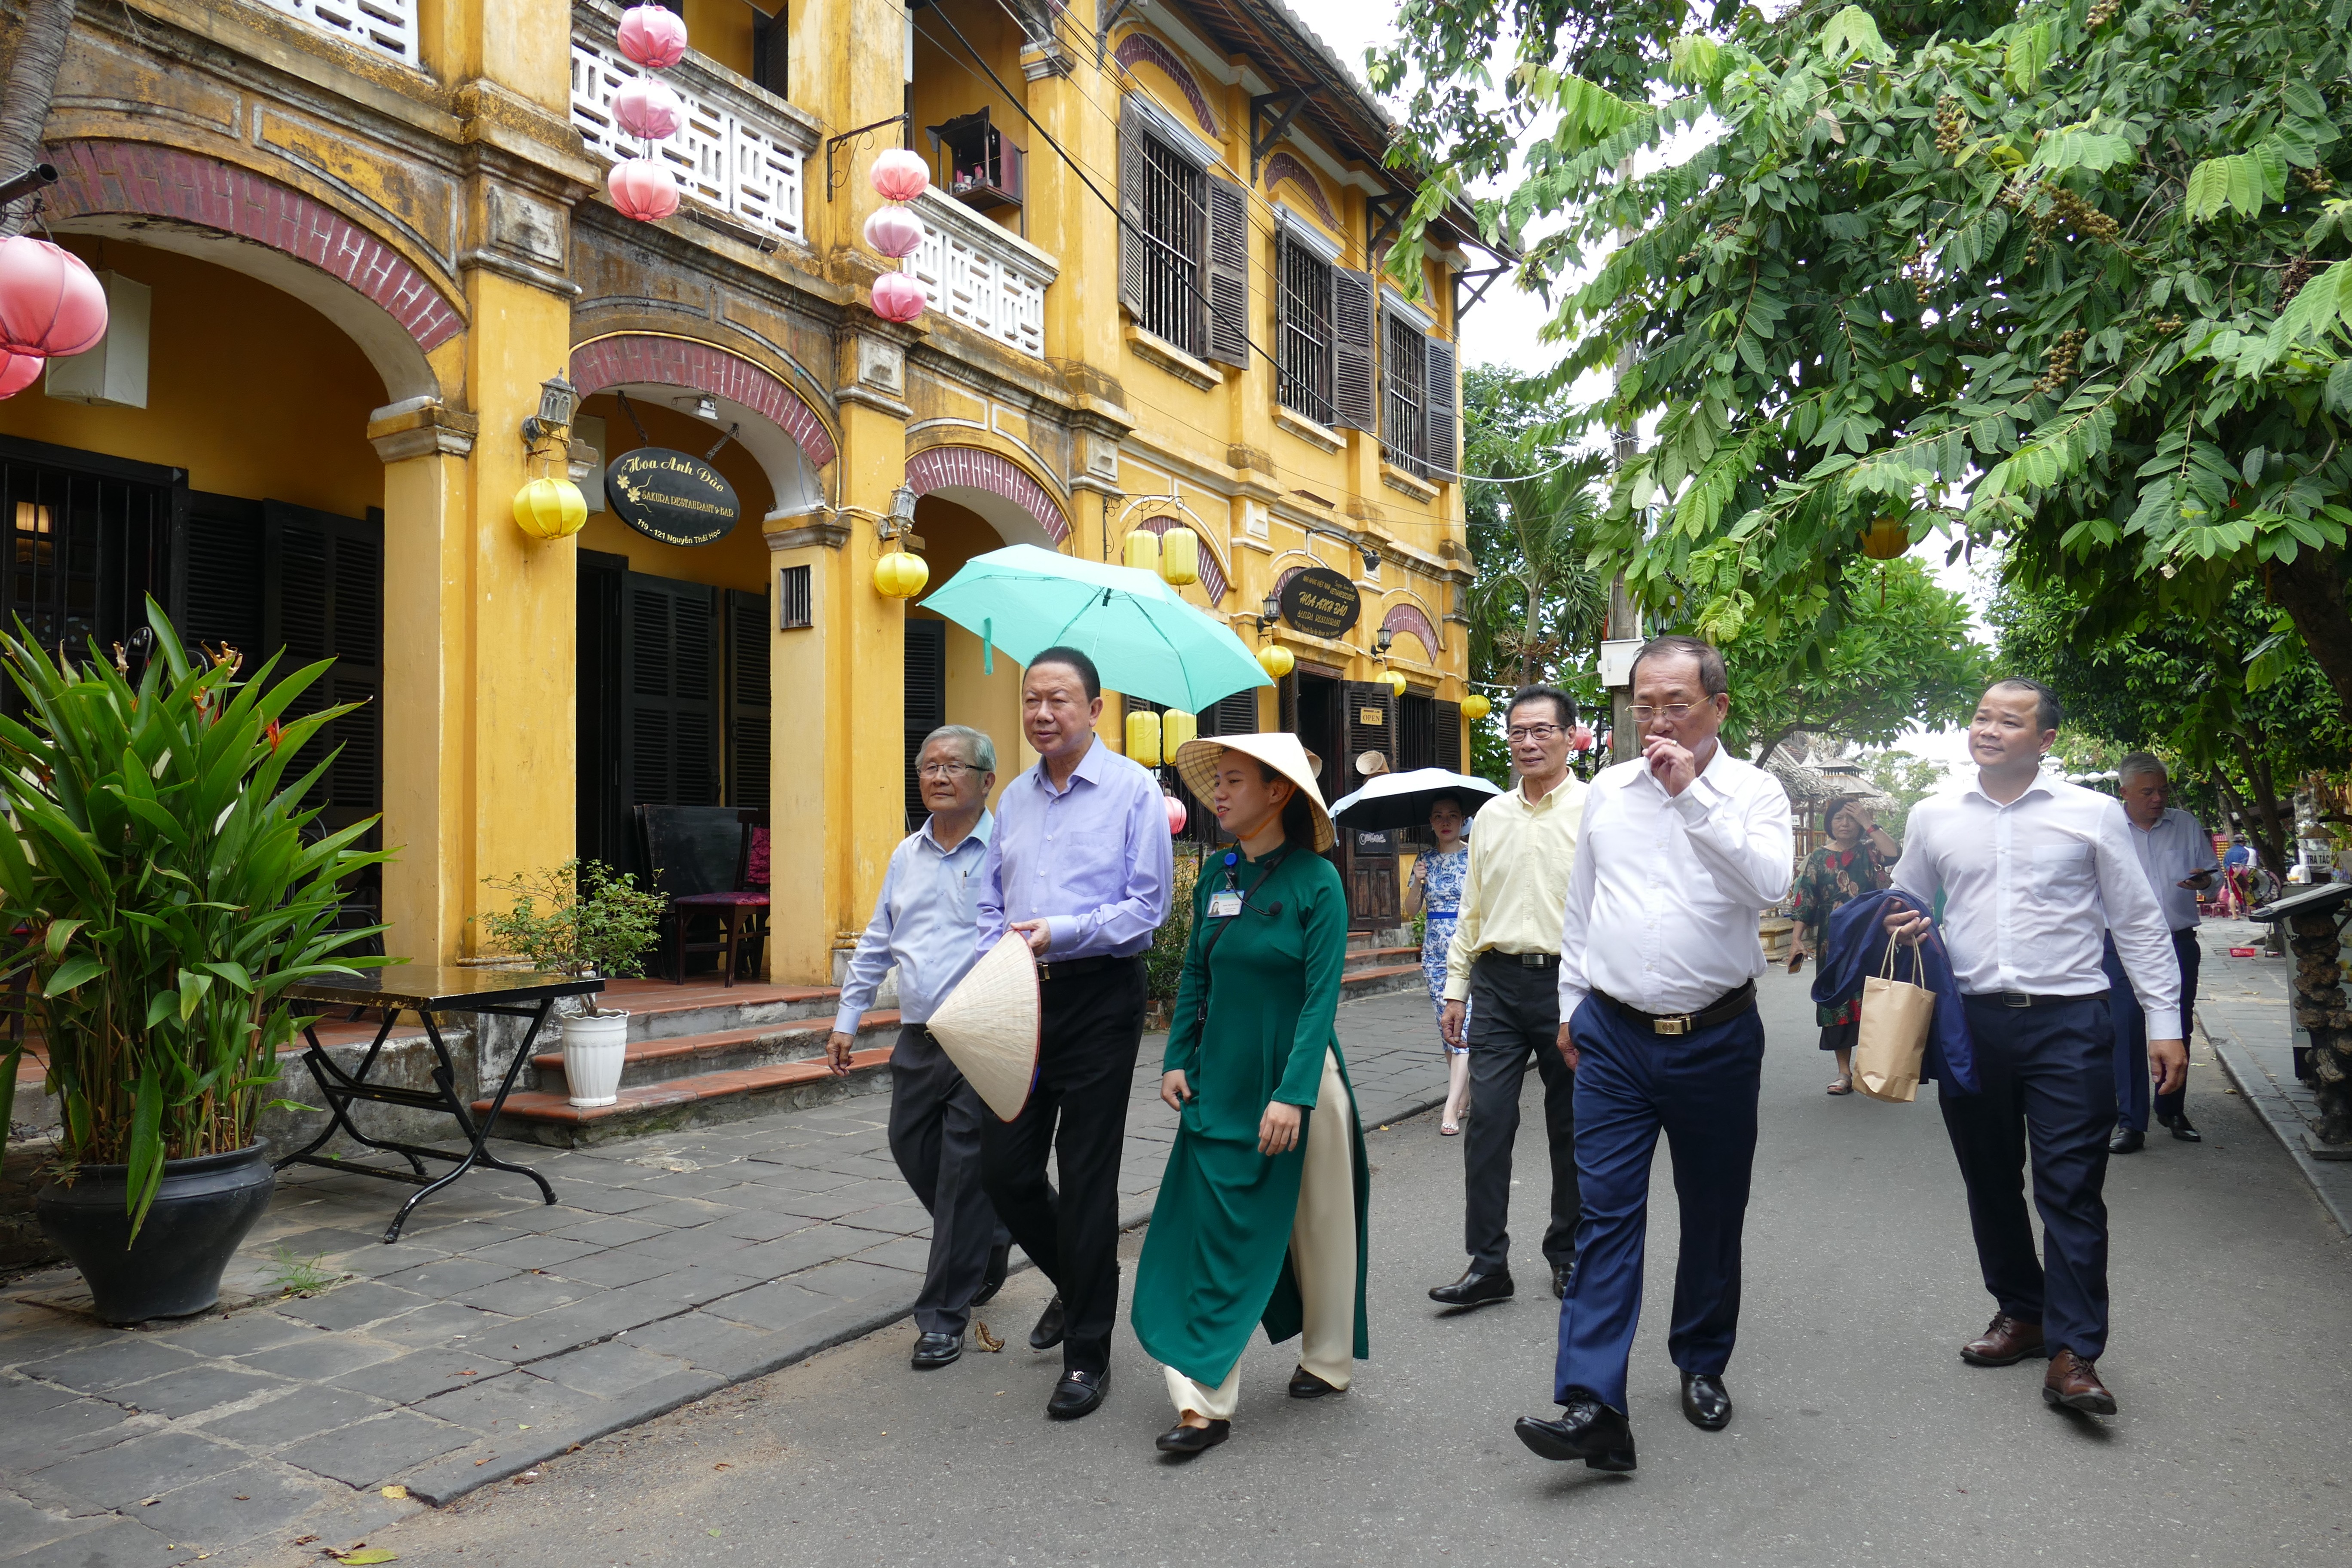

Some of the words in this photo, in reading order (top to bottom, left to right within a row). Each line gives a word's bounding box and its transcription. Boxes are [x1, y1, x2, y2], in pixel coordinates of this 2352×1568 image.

[627, 456, 658, 473] Hoa
[661, 456, 694, 475] Anh
[697, 468, 724, 492] Đào
[641, 490, 670, 504] SAKURA
[671, 496, 714, 513] RESTAURANT
[720, 506, 734, 518] BAR
[637, 518, 649, 530] 119
[654, 529, 666, 539] 121
[667, 534, 693, 545] Nguyễn
[693, 534, 708, 543] Thái
[708, 529, 721, 539] Học
[1299, 591, 1317, 607] HOA
[1315, 598, 1335, 612] ANH
[1297, 610, 1314, 621] SAKURA
[1315, 614, 1341, 627] RESTAURANT
[1363, 714, 1380, 722] OPEN
